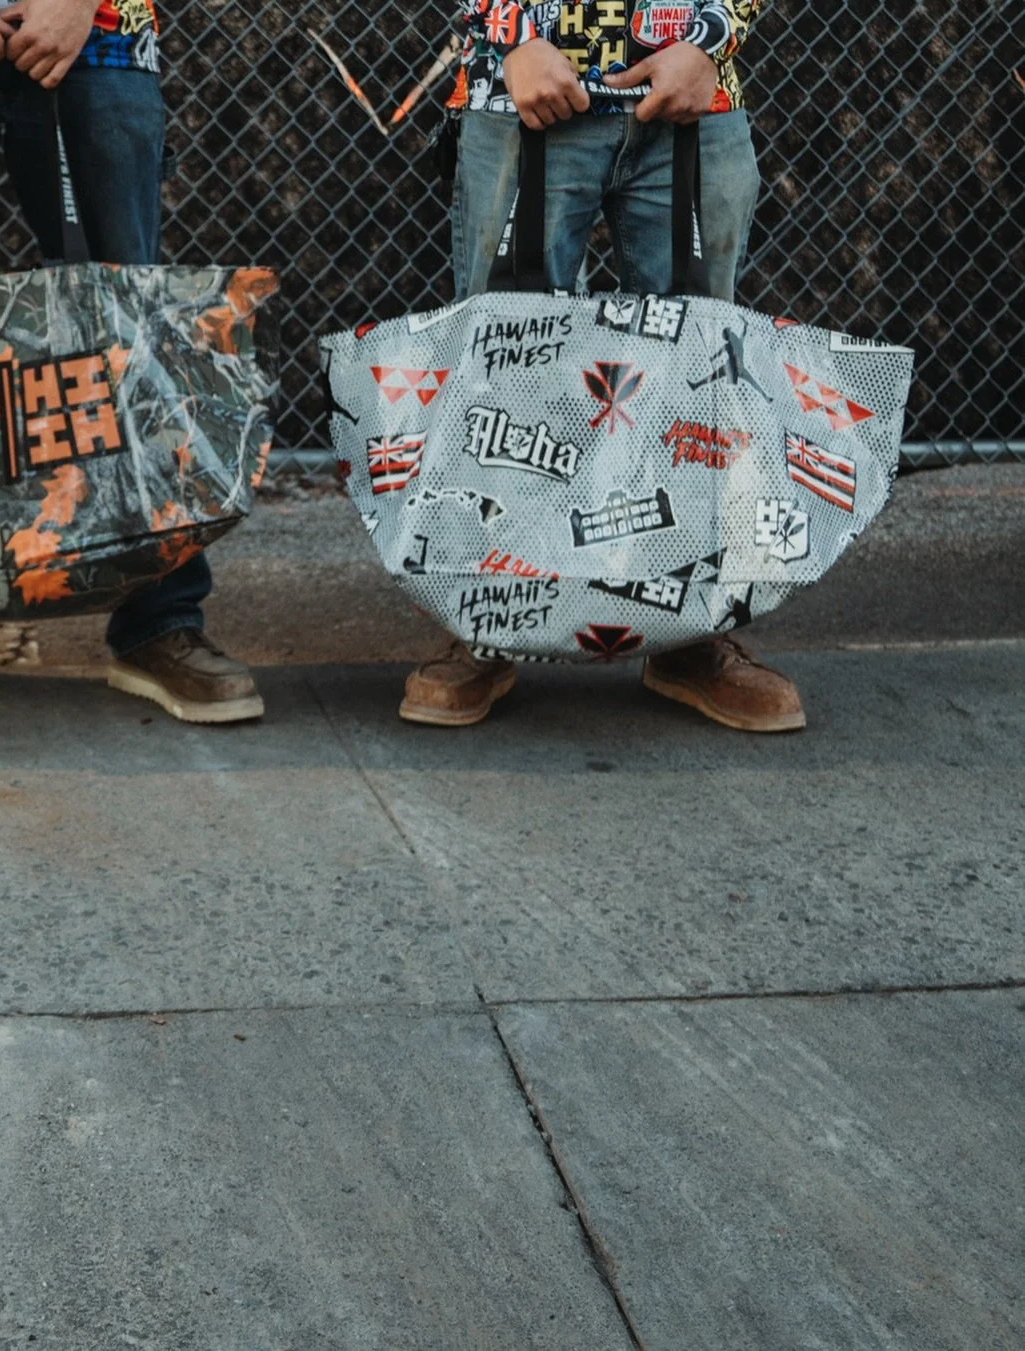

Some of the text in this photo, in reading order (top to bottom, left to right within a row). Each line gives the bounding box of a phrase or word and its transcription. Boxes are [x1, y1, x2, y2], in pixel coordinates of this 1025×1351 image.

[651, 6, 693, 22] HAWAII'S
[472, 314, 573, 360] HAWAII'S
[484, 341, 566, 381] FINEST
[464, 404, 583, 484] Aloha
[457, 579, 560, 625] HAWAII'S
[470, 604, 553, 646] FINEST
